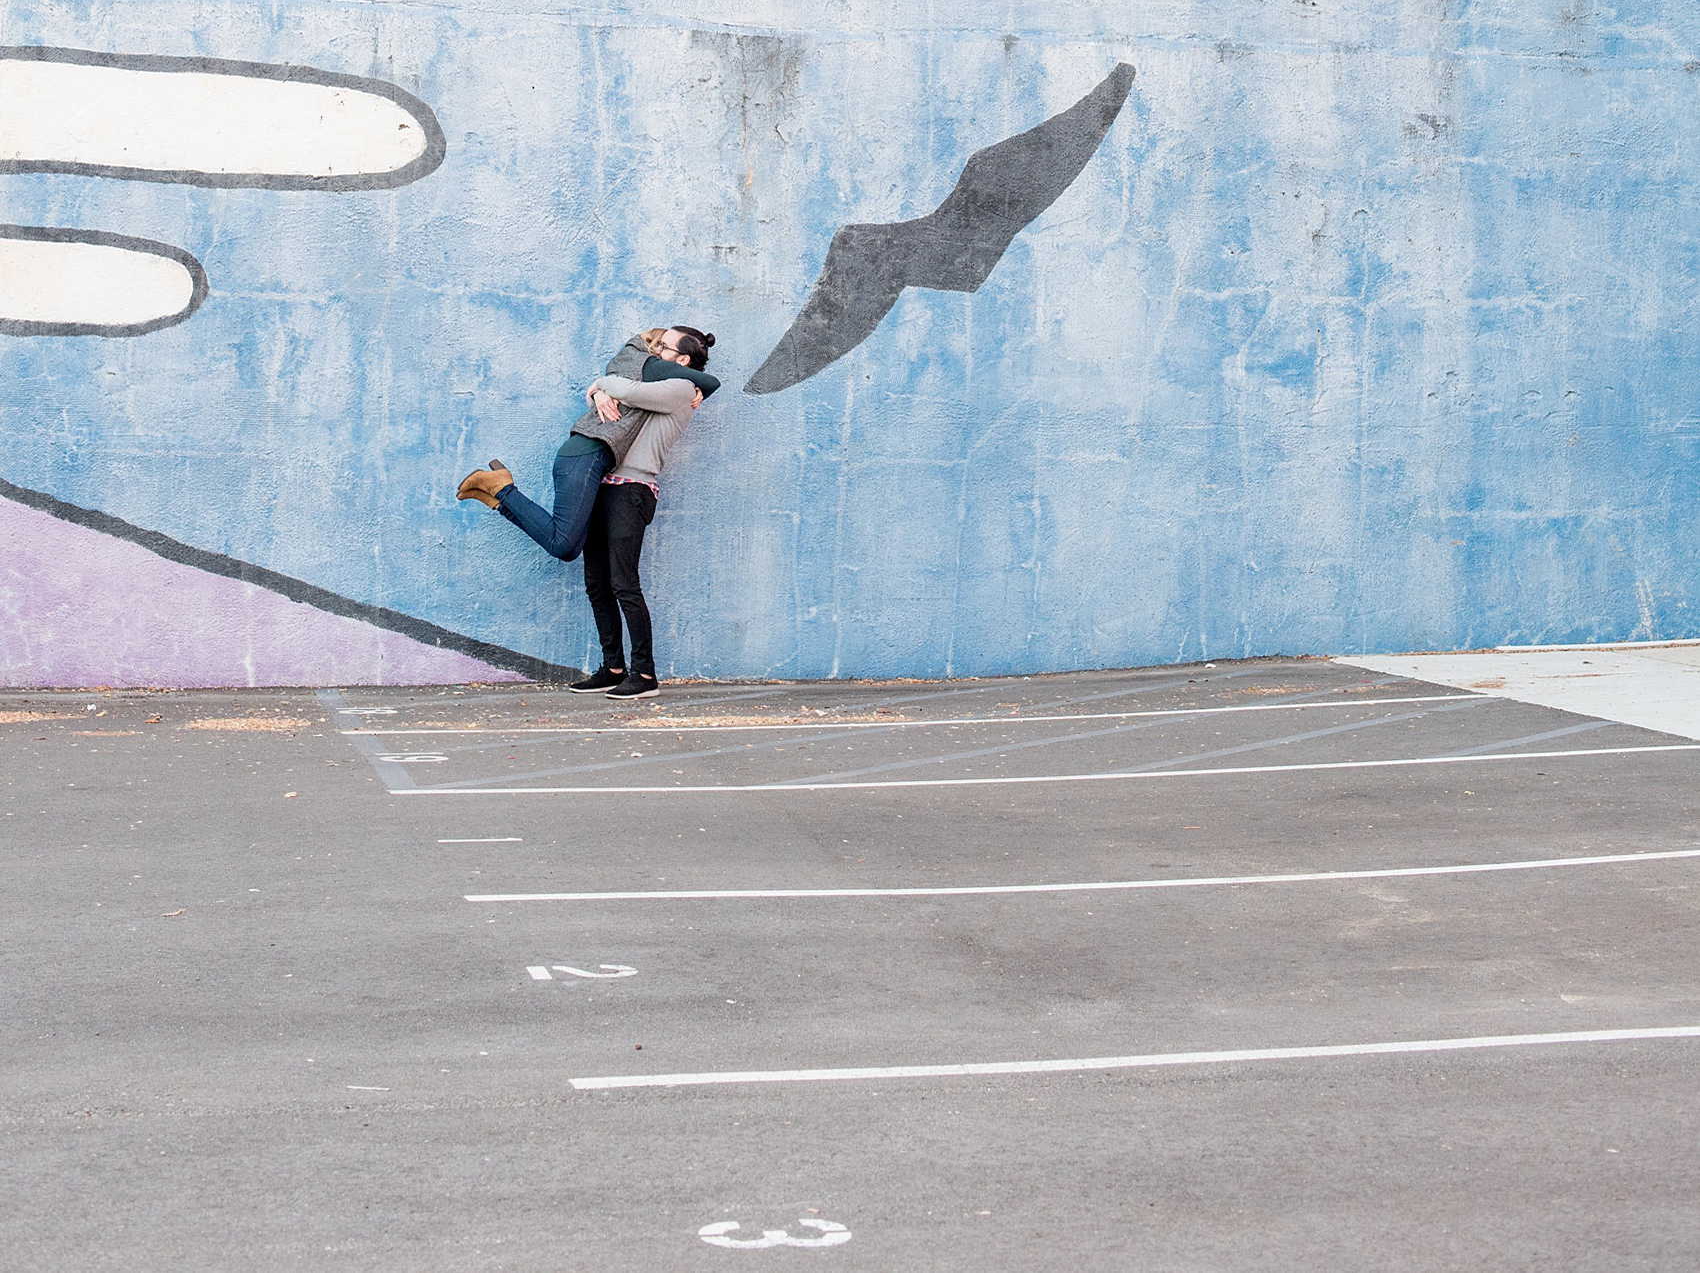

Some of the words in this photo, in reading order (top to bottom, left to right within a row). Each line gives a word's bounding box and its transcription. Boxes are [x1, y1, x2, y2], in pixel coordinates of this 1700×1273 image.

[374, 751, 450, 763] 19
[525, 964, 638, 980] 2
[697, 1218, 852, 1249] 3
